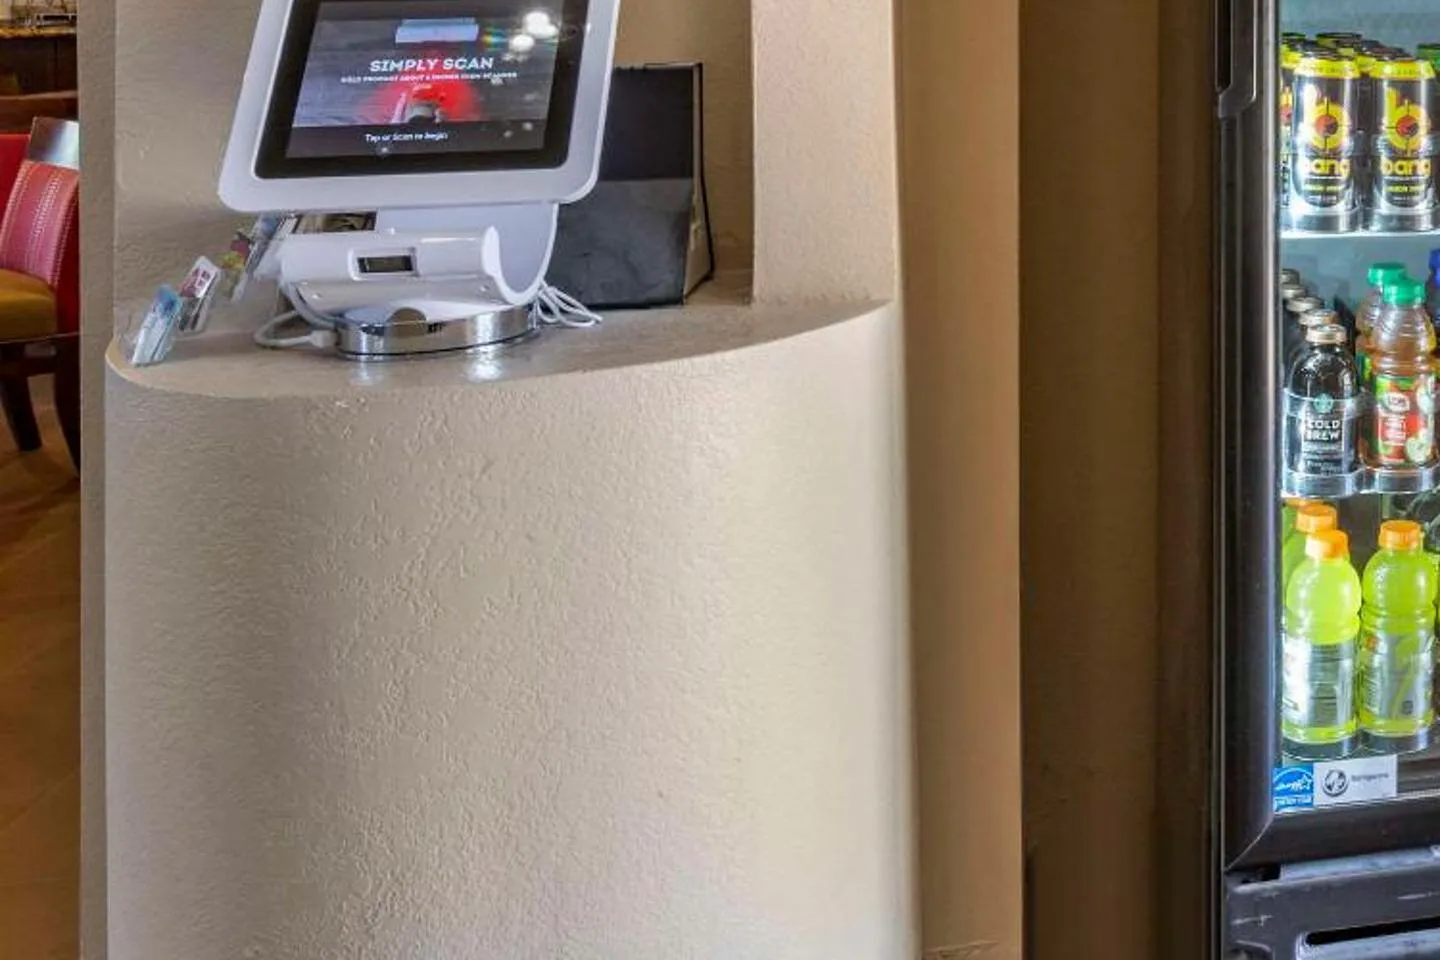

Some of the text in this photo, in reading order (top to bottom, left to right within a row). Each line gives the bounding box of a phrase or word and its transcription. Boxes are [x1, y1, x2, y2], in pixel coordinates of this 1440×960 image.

[369, 56, 494, 73] SIMPLY SCAN
[1306, 419, 1340, 430] COLD
[1304, 429, 1341, 441] BREW
